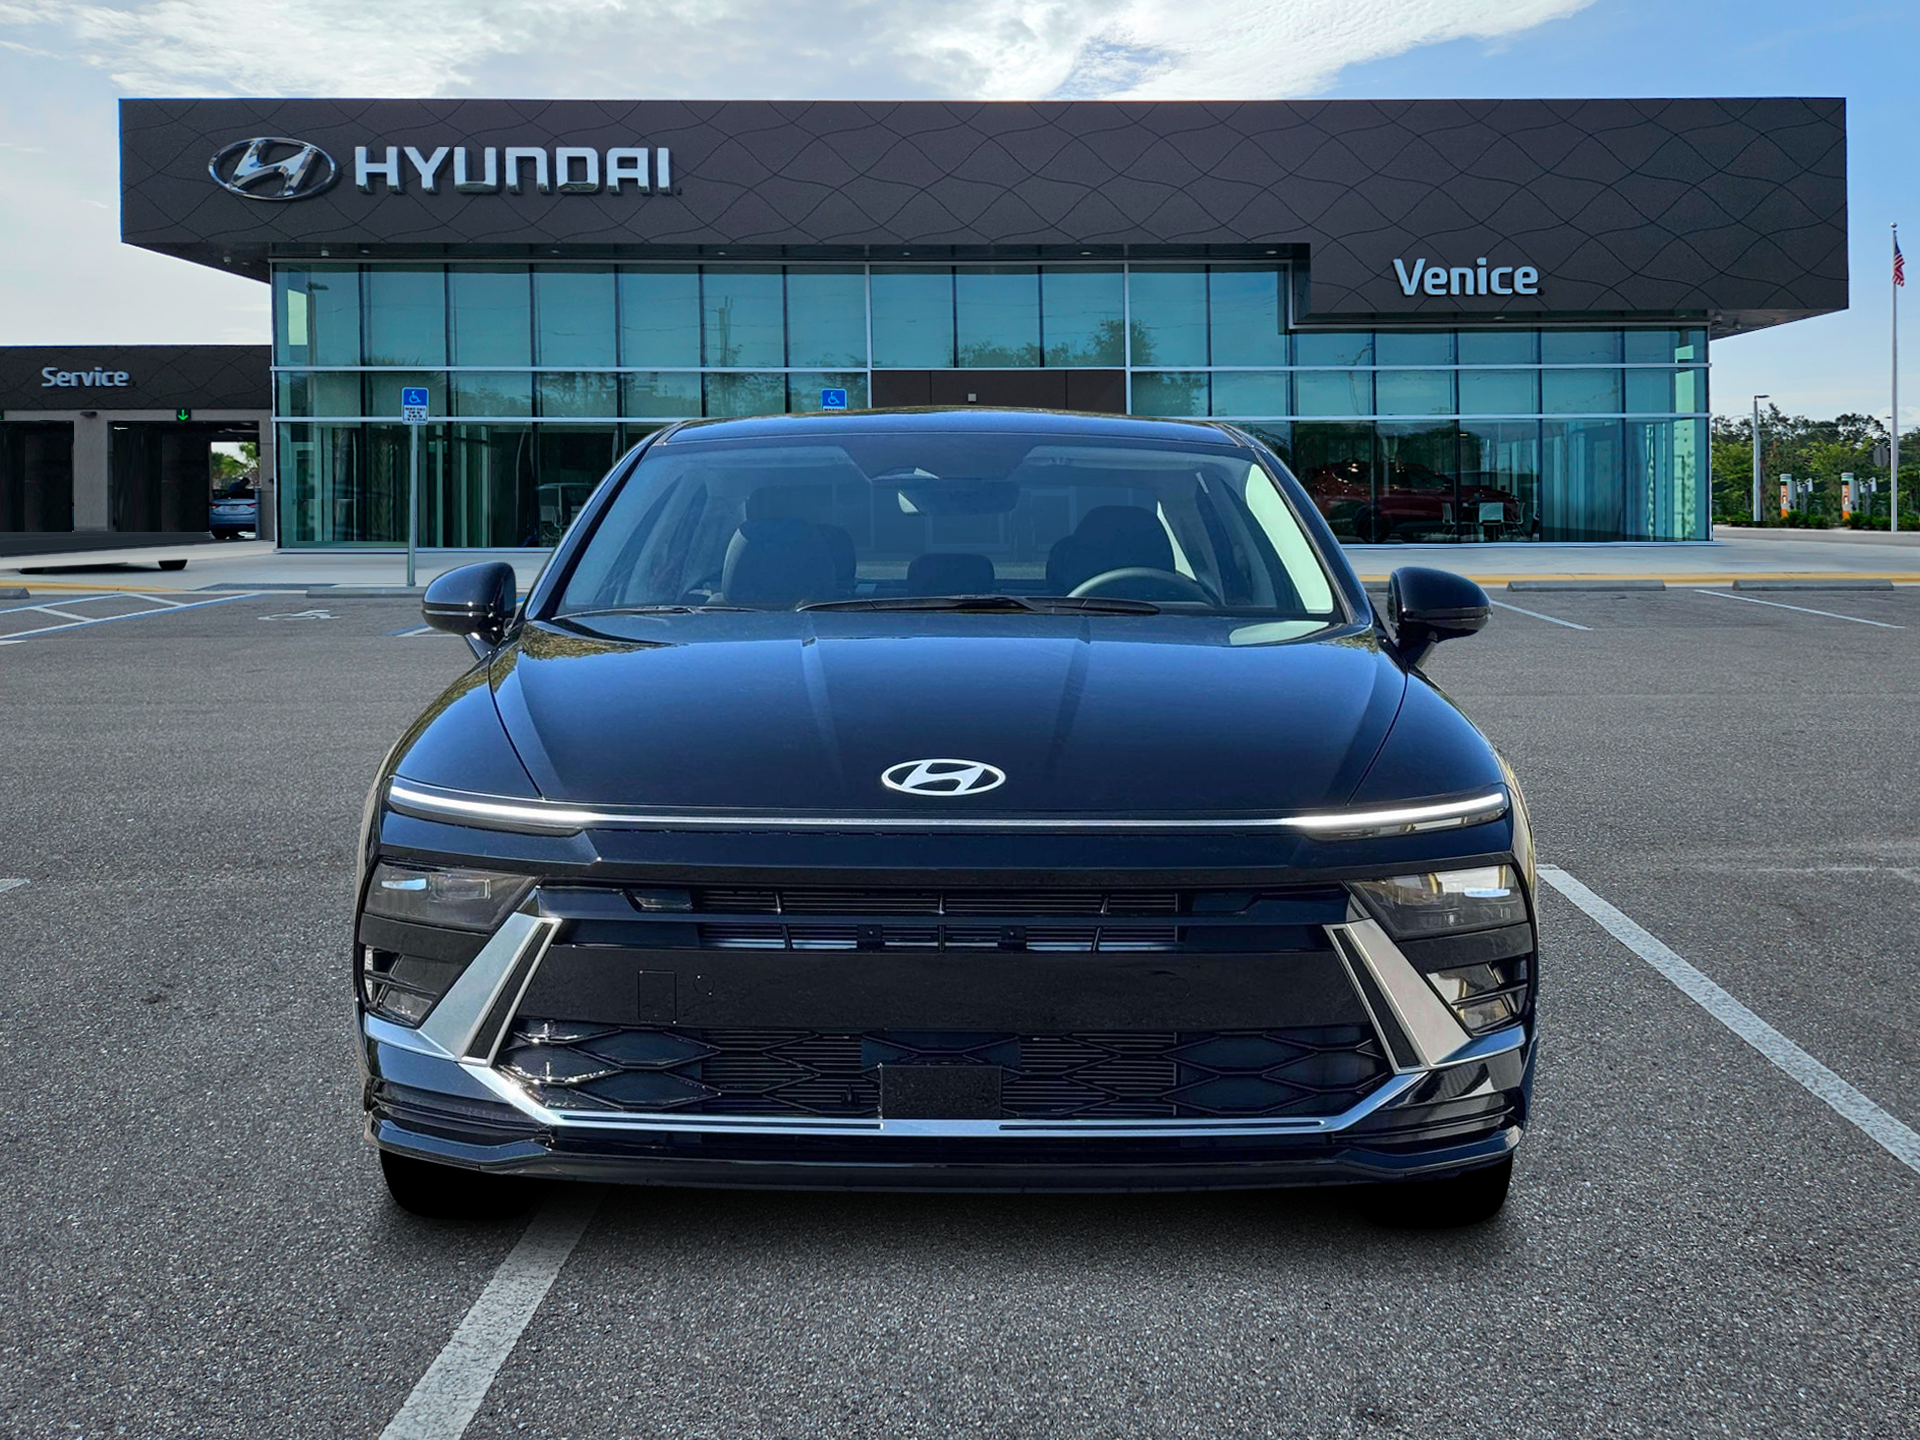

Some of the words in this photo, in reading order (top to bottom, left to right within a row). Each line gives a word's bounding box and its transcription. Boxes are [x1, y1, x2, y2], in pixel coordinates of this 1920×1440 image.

[354, 146, 672, 195] HYUNDAI
[1393, 257, 1539, 296] Venice
[41, 366, 130, 387] Service
